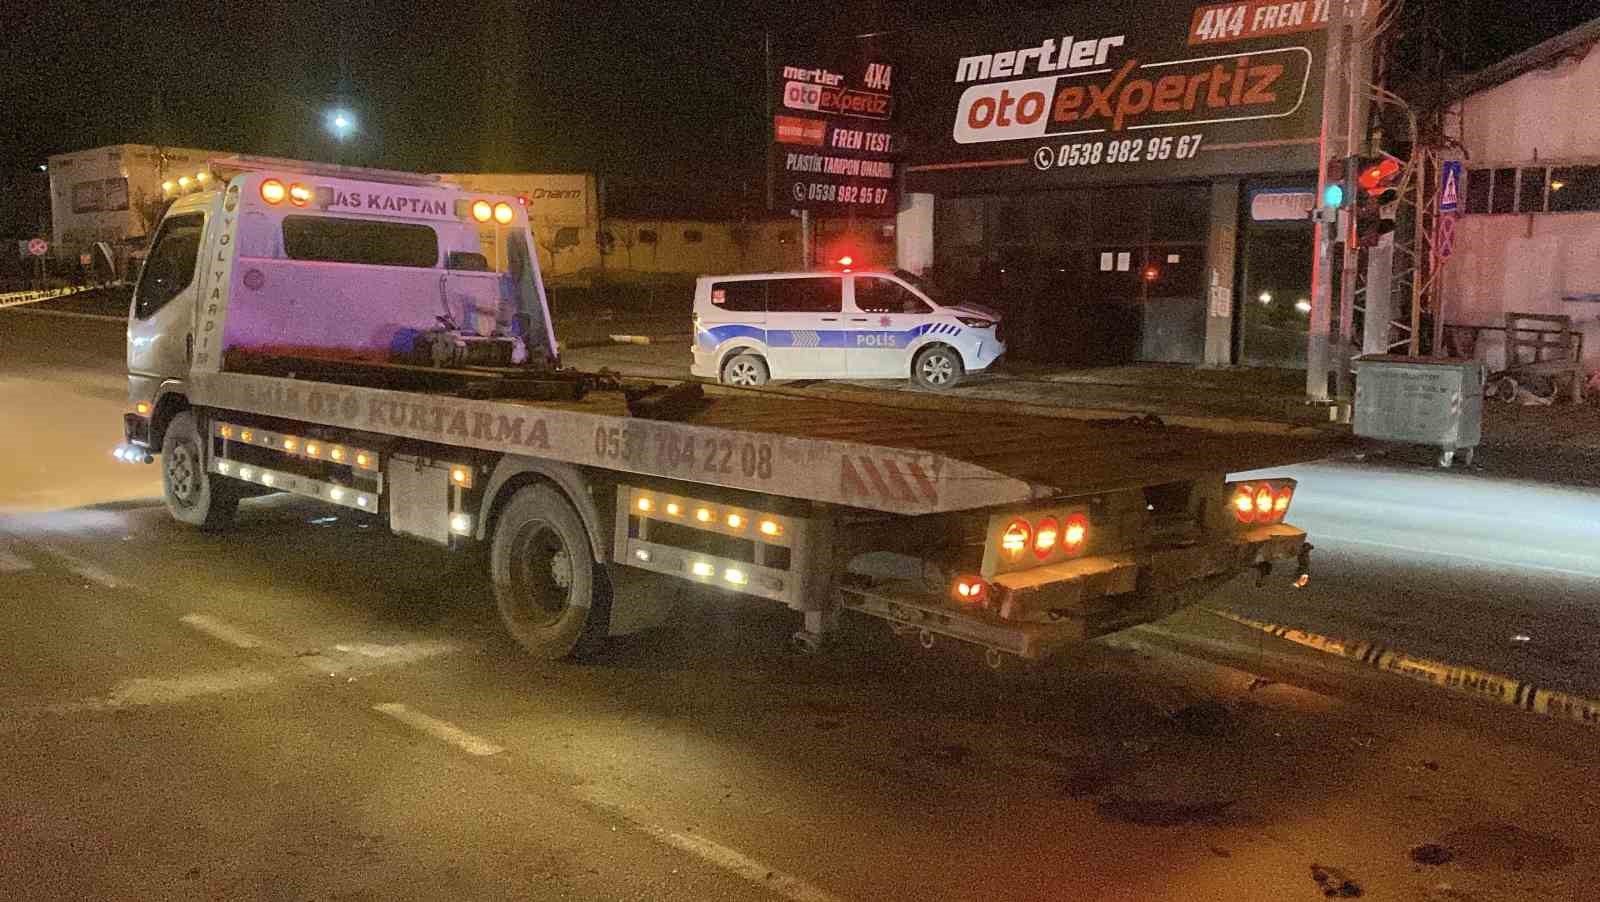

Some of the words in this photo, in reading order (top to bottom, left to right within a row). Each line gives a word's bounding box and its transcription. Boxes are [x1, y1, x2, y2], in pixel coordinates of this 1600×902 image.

[1196, 5, 1247, 40] 4X4
[1251, 2, 1305, 31] FREN
[955, 35, 1126, 83] mertler
[783, 66, 844, 86] mertler
[864, 63, 892, 91] 4X4
[832, 128, 863, 150] FREN
[1058, 143, 1101, 168] 0538
[1107, 139, 1140, 164] 982
[1146, 137, 1169, 161] 95
[1177, 134, 1202, 159] 67
[824, 157, 860, 176] TAMPON
[367, 194, 447, 216] KAPTAN
[809, 183, 836, 201] 0538
[838, 186, 859, 203] 982
[860, 188, 873, 204] 95
[874, 188, 888, 205] 67
[857, 332, 896, 347] POLİS
[369, 398, 550, 449] KURTARMA
[704, 437, 733, 475] 22
[741, 443, 772, 480] 08
